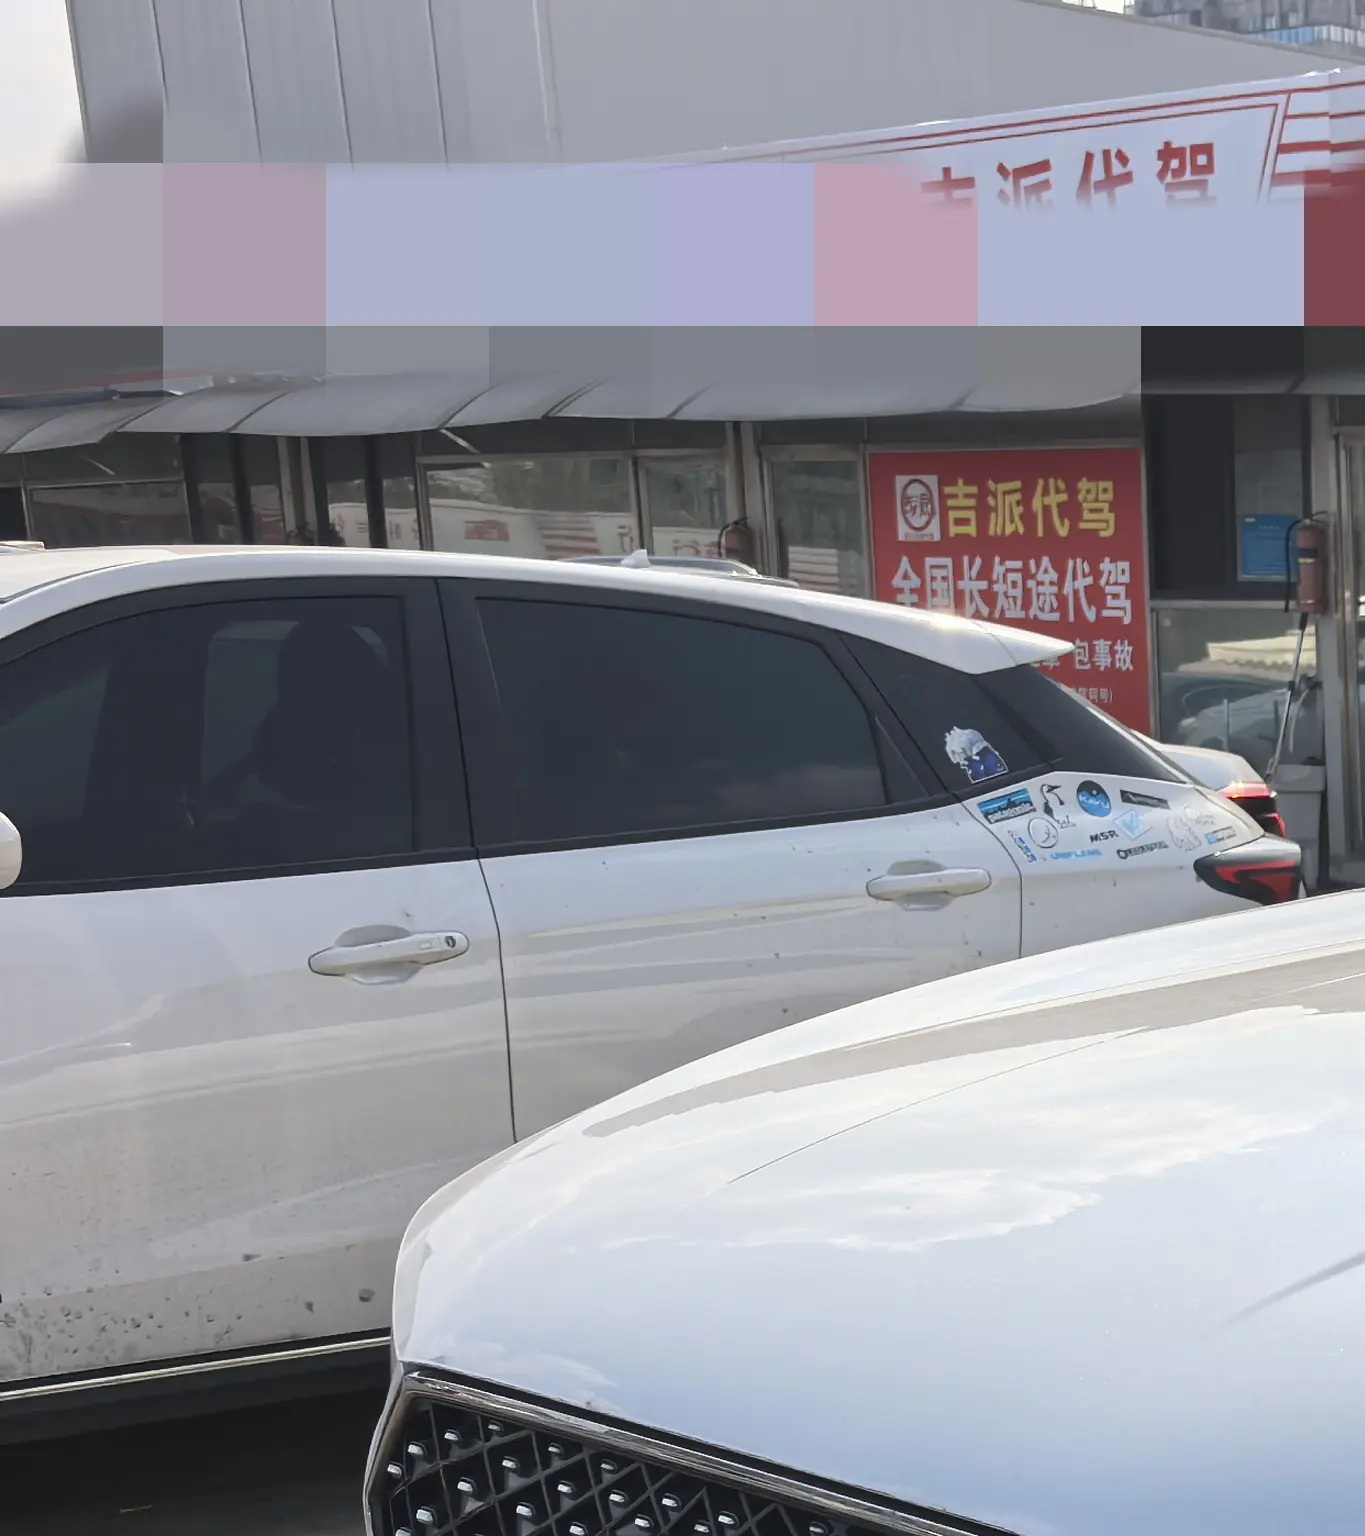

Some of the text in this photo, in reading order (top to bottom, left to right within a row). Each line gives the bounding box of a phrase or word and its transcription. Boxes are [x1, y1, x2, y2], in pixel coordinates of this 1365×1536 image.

[942, 477, 1117, 538] 吉派代驾
[891, 554, 1133, 625] 全国长短途代驾
[1074, 638, 1134, 672] 包事故
[1089, 830, 1120, 844] MSR
